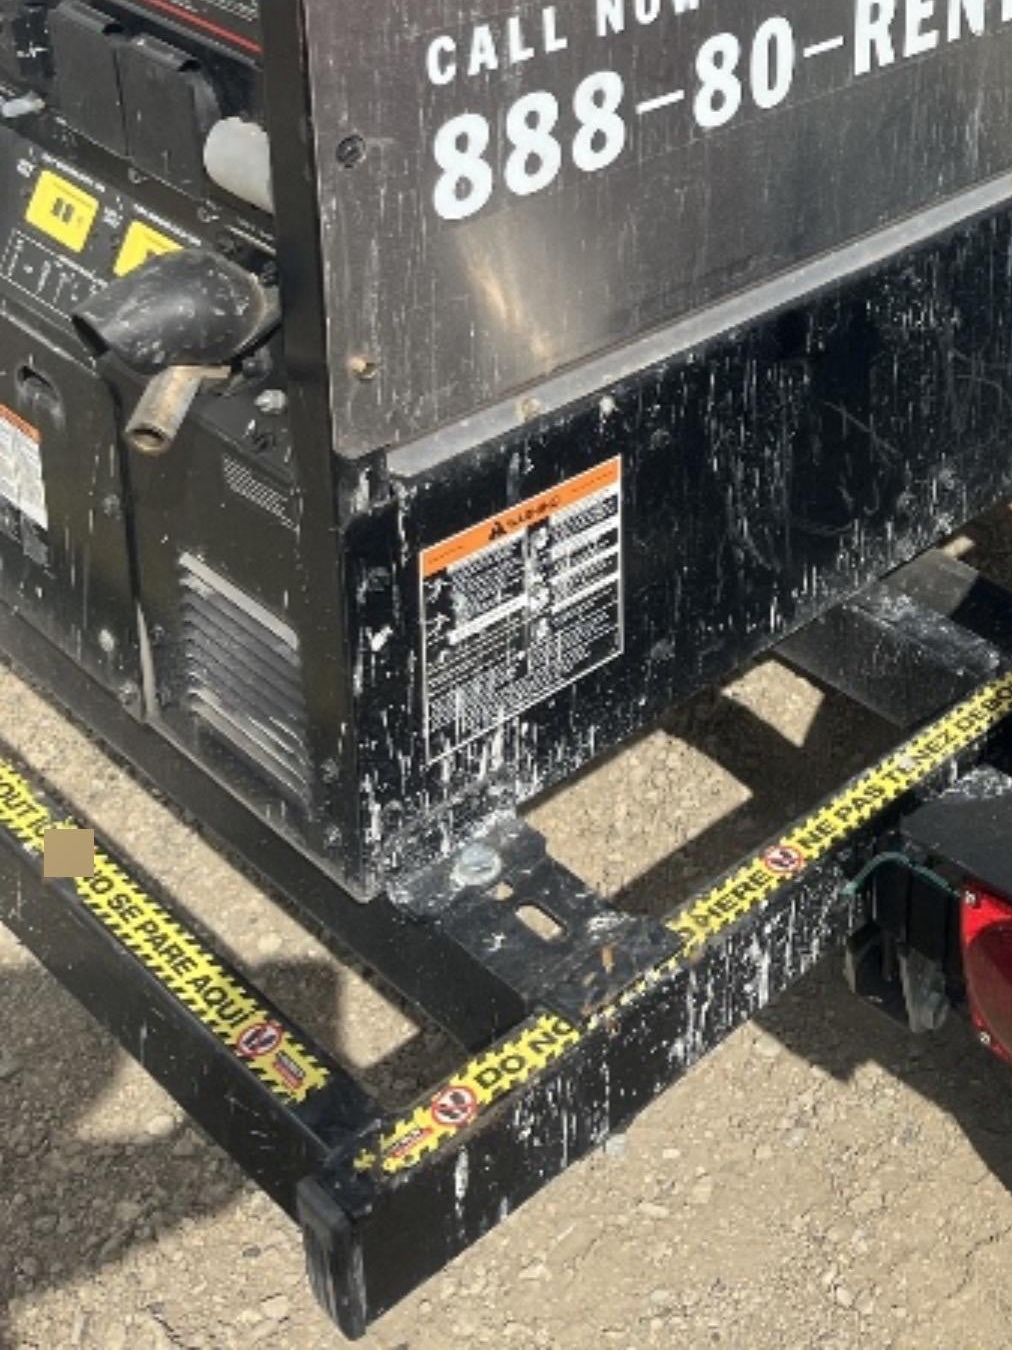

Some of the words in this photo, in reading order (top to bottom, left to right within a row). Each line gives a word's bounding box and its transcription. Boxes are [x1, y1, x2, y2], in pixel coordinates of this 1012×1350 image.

[426, 6, 568, 85] CALL
[107, 893, 145, 923] SE
[134, 919, 199, 977] PARE
[474, 1054, 526, 1090] DO
